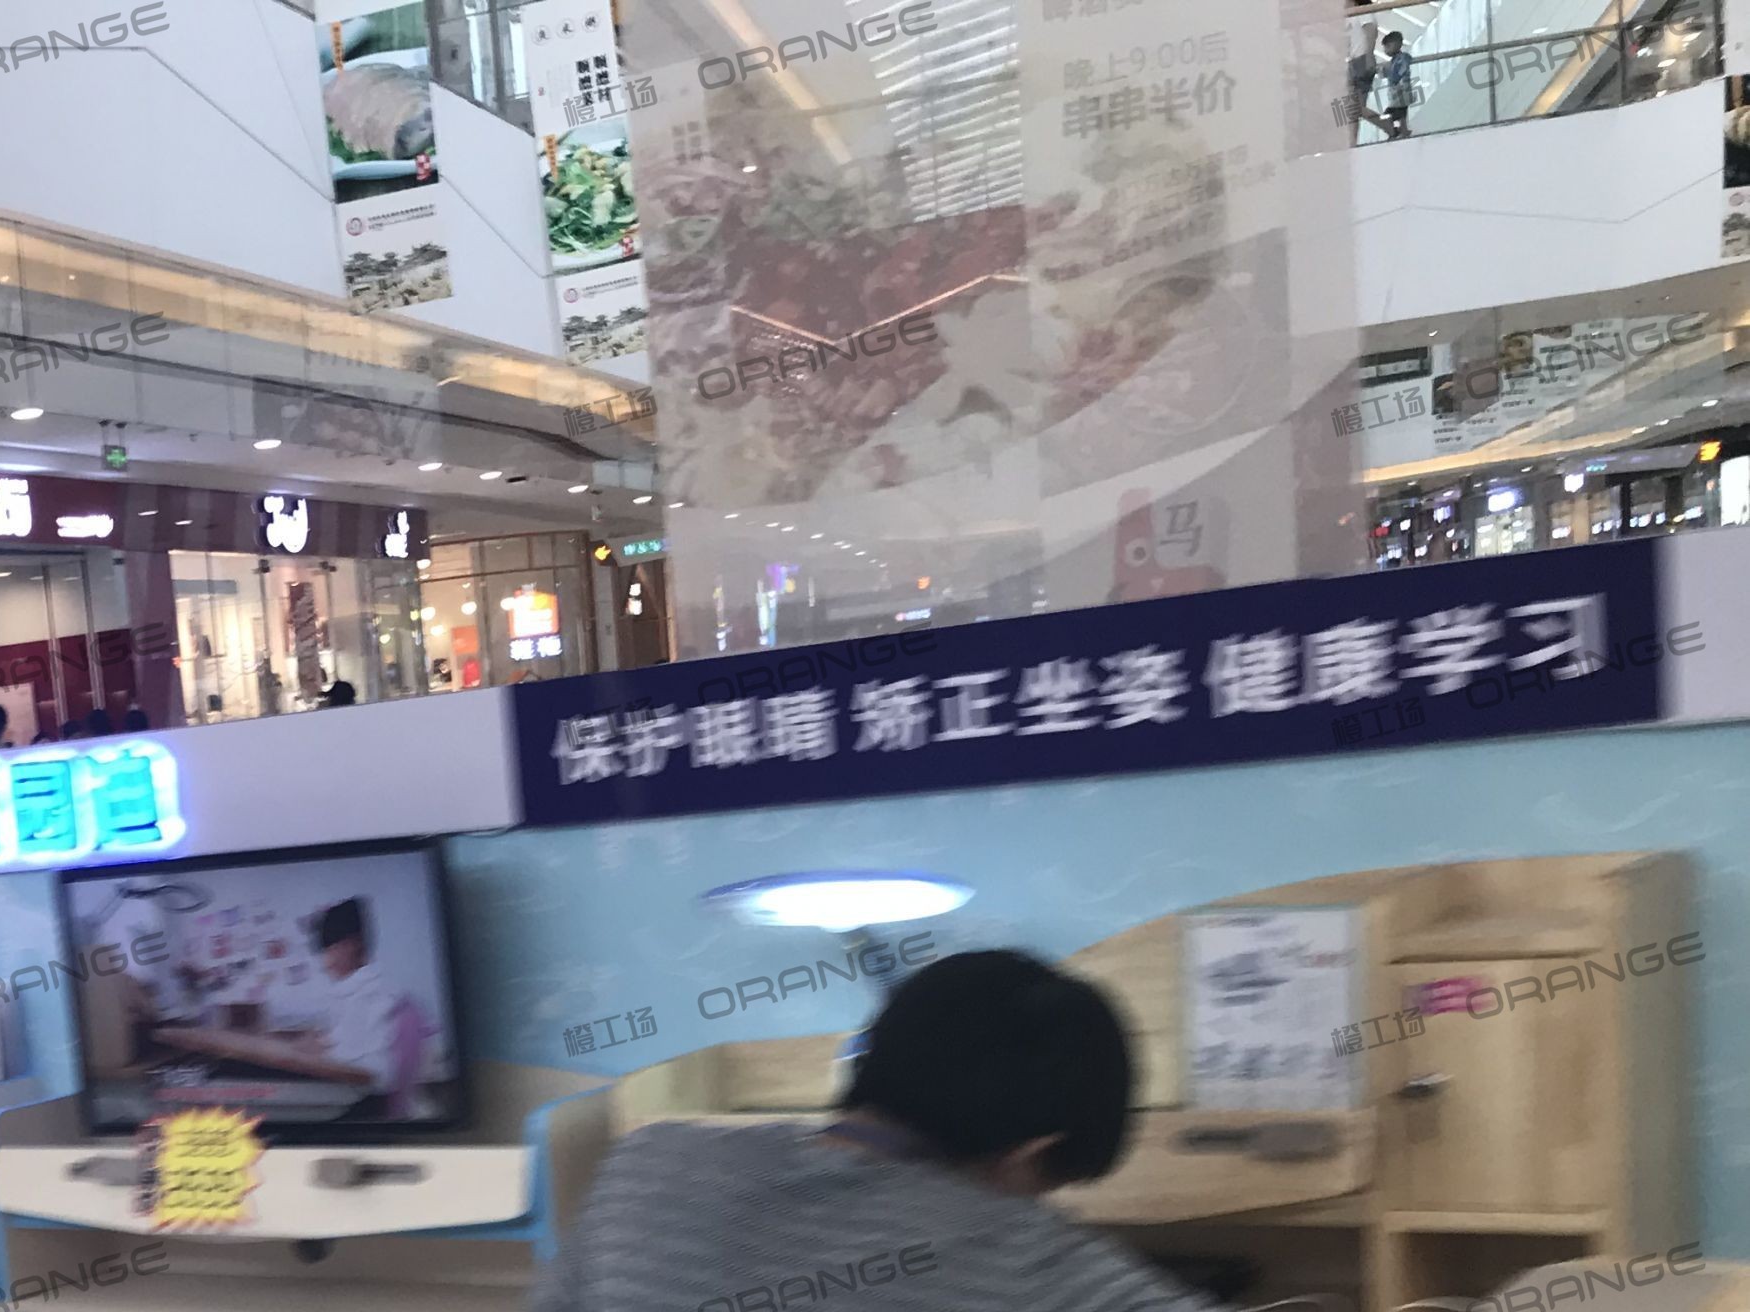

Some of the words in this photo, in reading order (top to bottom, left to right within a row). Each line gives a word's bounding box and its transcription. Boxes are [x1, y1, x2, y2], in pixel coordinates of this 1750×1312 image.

[1062, 70, 1236, 138] 串串半价
[553, 686, 840, 787] 保护眼睛
[852, 641, 1194, 753] 矫正坐姿
[1204, 592, 1610, 719] 健康学习
